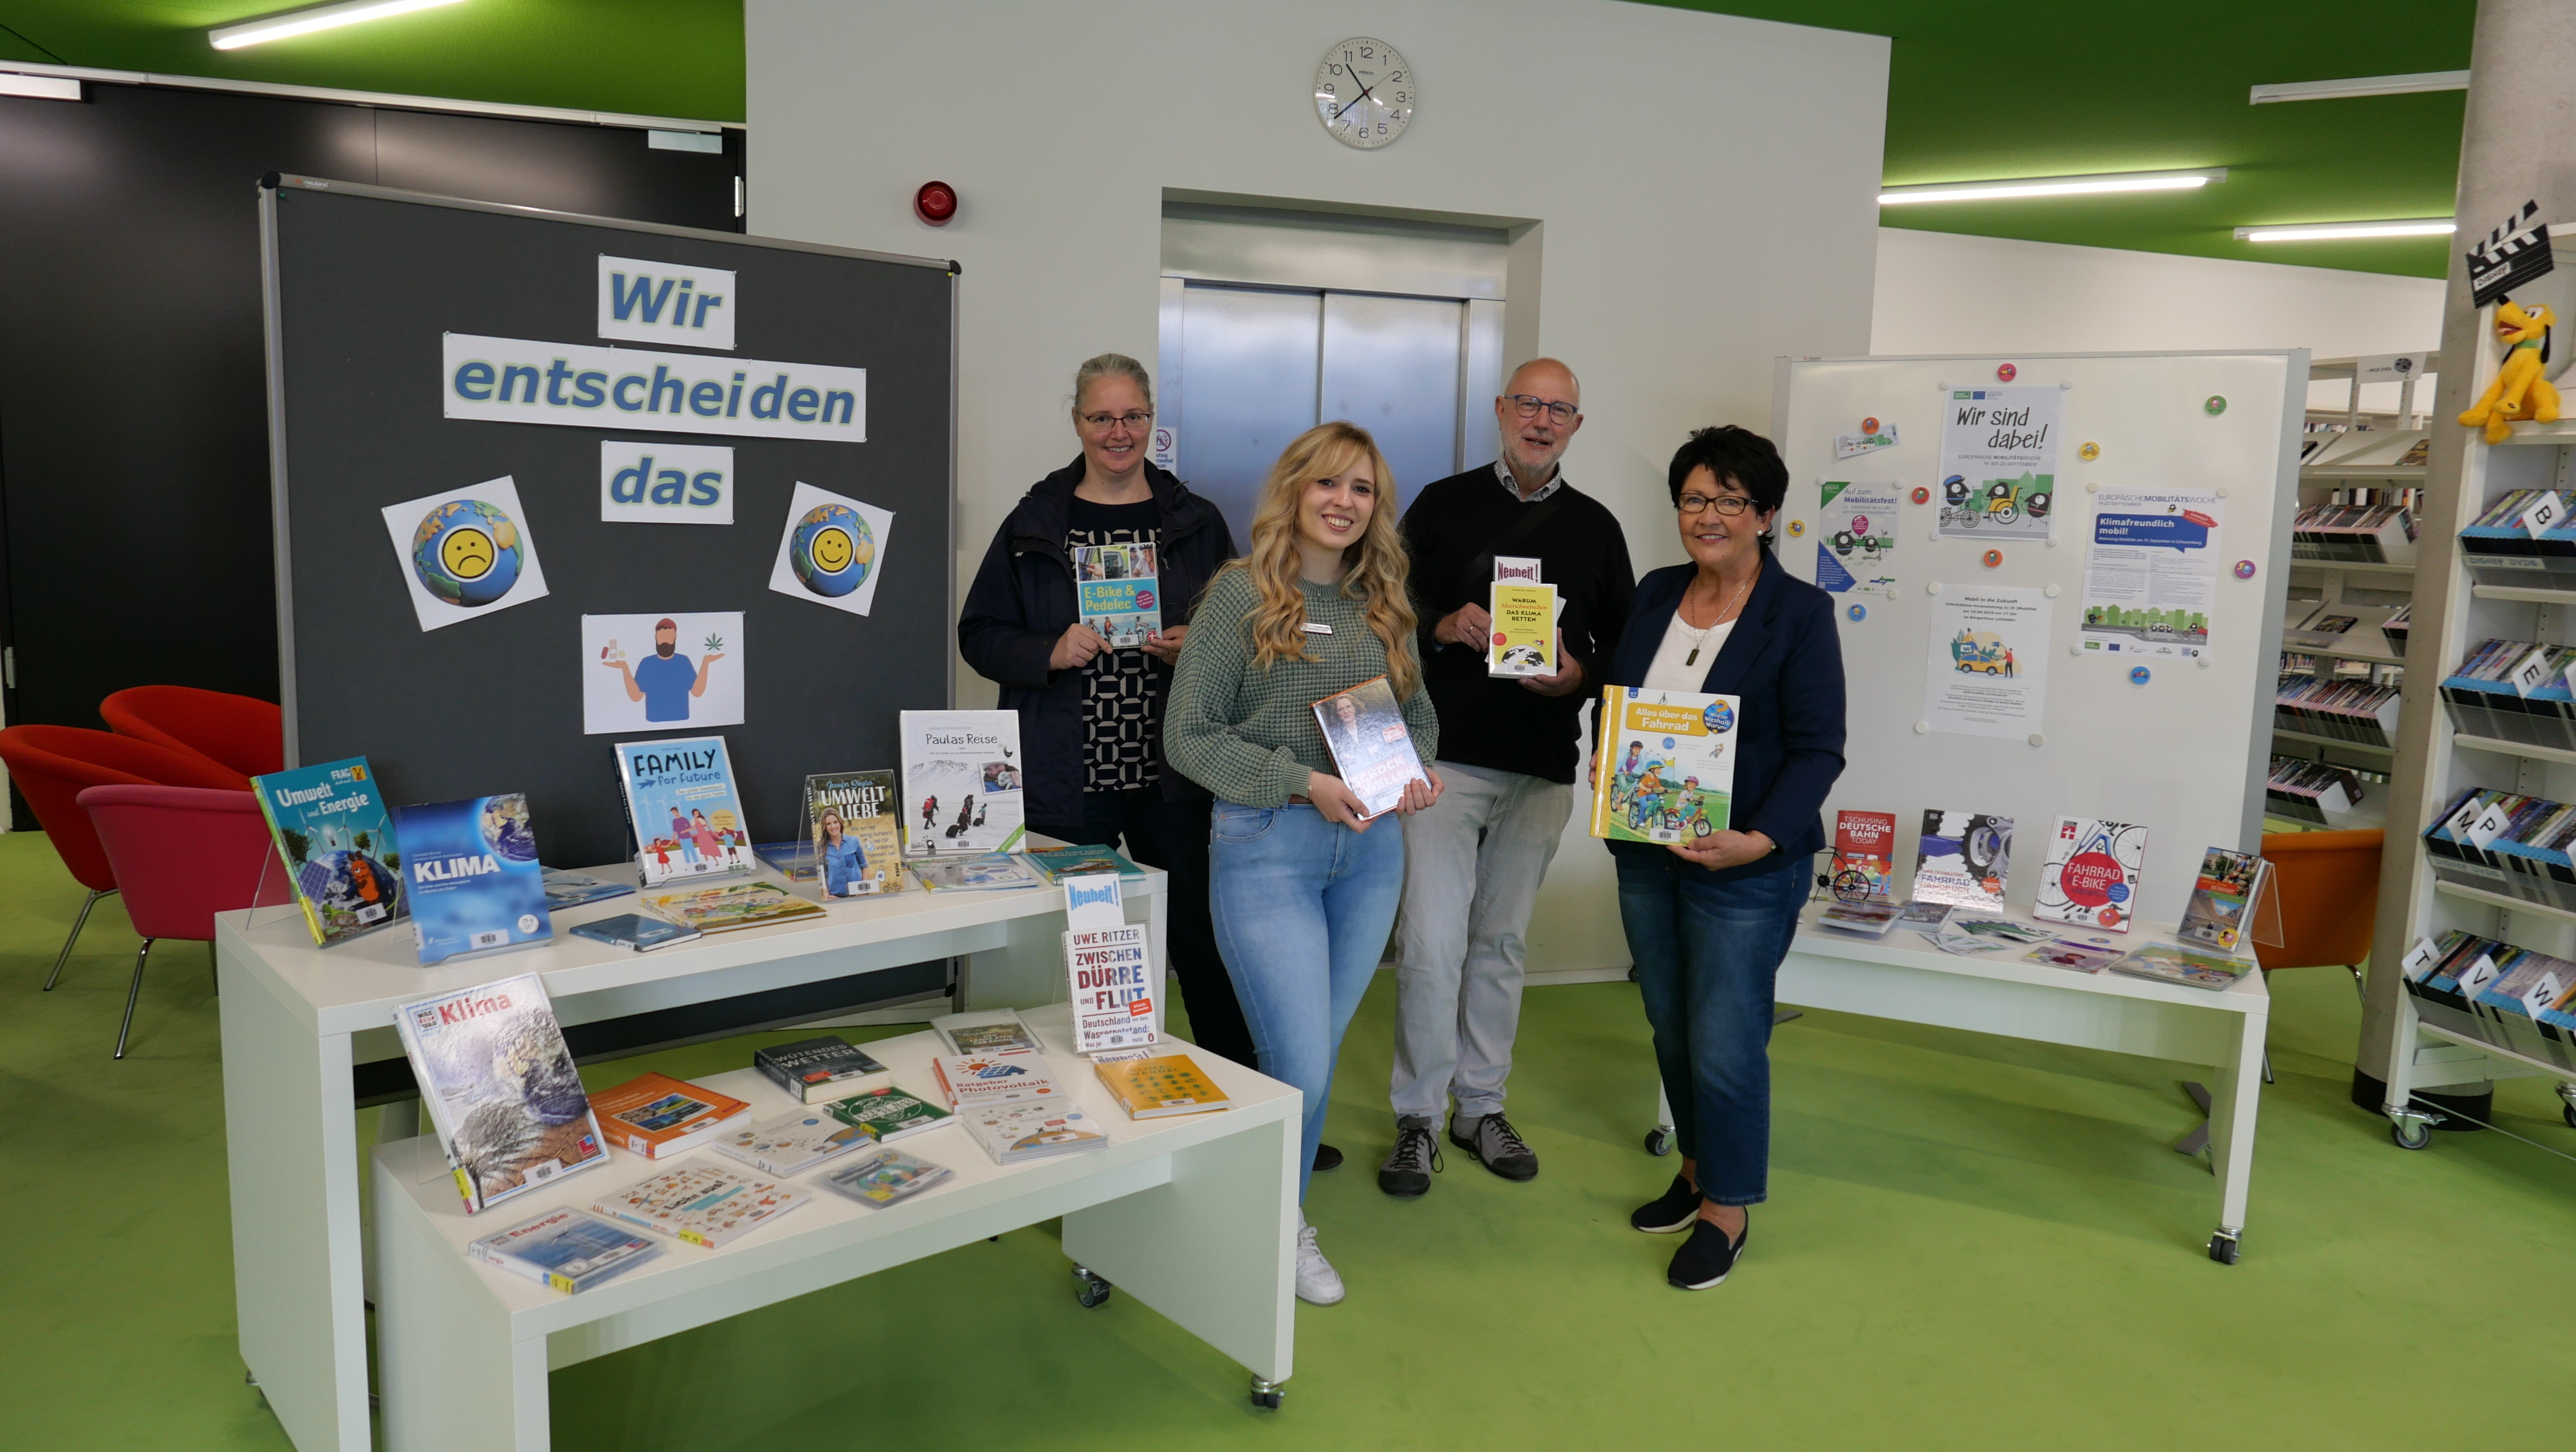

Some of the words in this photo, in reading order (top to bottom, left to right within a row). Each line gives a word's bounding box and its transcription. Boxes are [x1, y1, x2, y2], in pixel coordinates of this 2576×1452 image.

[1344, 50, 1352, 62] 11
[1360, 46, 1373, 58] 12
[1383, 54, 1386, 66] 1
[1328, 64, 1342, 76] 10
[1392, 71, 1402, 82] 2
[1324, 83, 1334, 94] 9
[1396, 91, 1406, 102] 3
[1328, 103, 1338, 114] 8
[1390, 110, 1400, 120] 4
[1342, 120, 1352, 131] 7
[1359, 127, 1369, 138] 6
[1378, 123, 1388, 134] 5
[608, 272, 722, 329] Wir
[454, 359, 856, 424] entscheiden
[1956, 406, 1986, 426] Wir
[1990, 406, 2030, 426] sind
[1988, 424, 2048, 450] dabei!
[610, 456, 722, 506] das
[2534, 504, 2552, 525] B
[2100, 518, 2174, 528] Klimafreundlich
[2099, 527, 2128, 535] mobil!
[1084, 586, 1122, 598] E-Bike
[1126, 584, 1135, 596] &
[1085, 598, 1132, 612] Pedelec
[2523, 664, 2540, 685] E
[1636, 708, 1658, 717] Alles
[1659, 710, 1680, 718] über
[1682, 712, 1698, 720] das
[1642, 717, 1690, 731] Fahrrad
[926, 734, 964, 744] Paulas
[966, 734, 998, 744] Reise
[634, 749, 716, 776] FAMILY
[330, 768, 350, 780] FRAG
[1352, 756, 1404, 786] SCHOCK
[658, 776, 676, 786] for
[680, 772, 721, 784] Future
[1363, 766, 1416, 794] WELLEN
[276, 782, 334, 807] Umwelt
[821, 786, 886, 806] UMWELT
[306, 810, 320, 818] und
[319, 792, 369, 816] Energie
[838, 802, 881, 820] LIEBE
[1840, 822, 1892, 833] DEUTSCHE
[1844, 816, 1888, 825] TSCHUSING
[2457, 810, 2476, 834] M
[2479, 816, 2496, 833] P
[1850, 830, 1878, 838] BAHN
[414, 854, 500, 883] KLIMA
[2068, 862, 2120, 880] FAHRRAD
[1920, 882, 1970, 893] HANDBUCH
[1921, 874, 1970, 886] FAHRRAD
[2072, 875, 2107, 890] E-BIKE
[1074, 932, 1098, 945] UWE
[1102, 930, 1140, 942] RITZER
[1076, 948, 1142, 966] ZWISCHEN
[2415, 949, 2431, 966] T
[1078, 964, 1144, 990] DÜRRE
[2473, 967, 2488, 986] V
[1096, 987, 1145, 1010] FLUT
[2534, 982, 2554, 1007] W
[438, 994, 512, 1026] Klima
[1082, 1016, 1130, 1028] Deutschland
[775, 1044, 848, 1062] WÜTENDES
[780, 1049, 856, 1069] WETTER
[956, 1079, 1008, 1088] Ratgeber
[959, 1079, 1050, 1092] Photovoltaik
[664, 1194, 700, 1210] Licht
[700, 1180, 726, 1194] aus!
[509, 1214, 569, 1237] Energie
